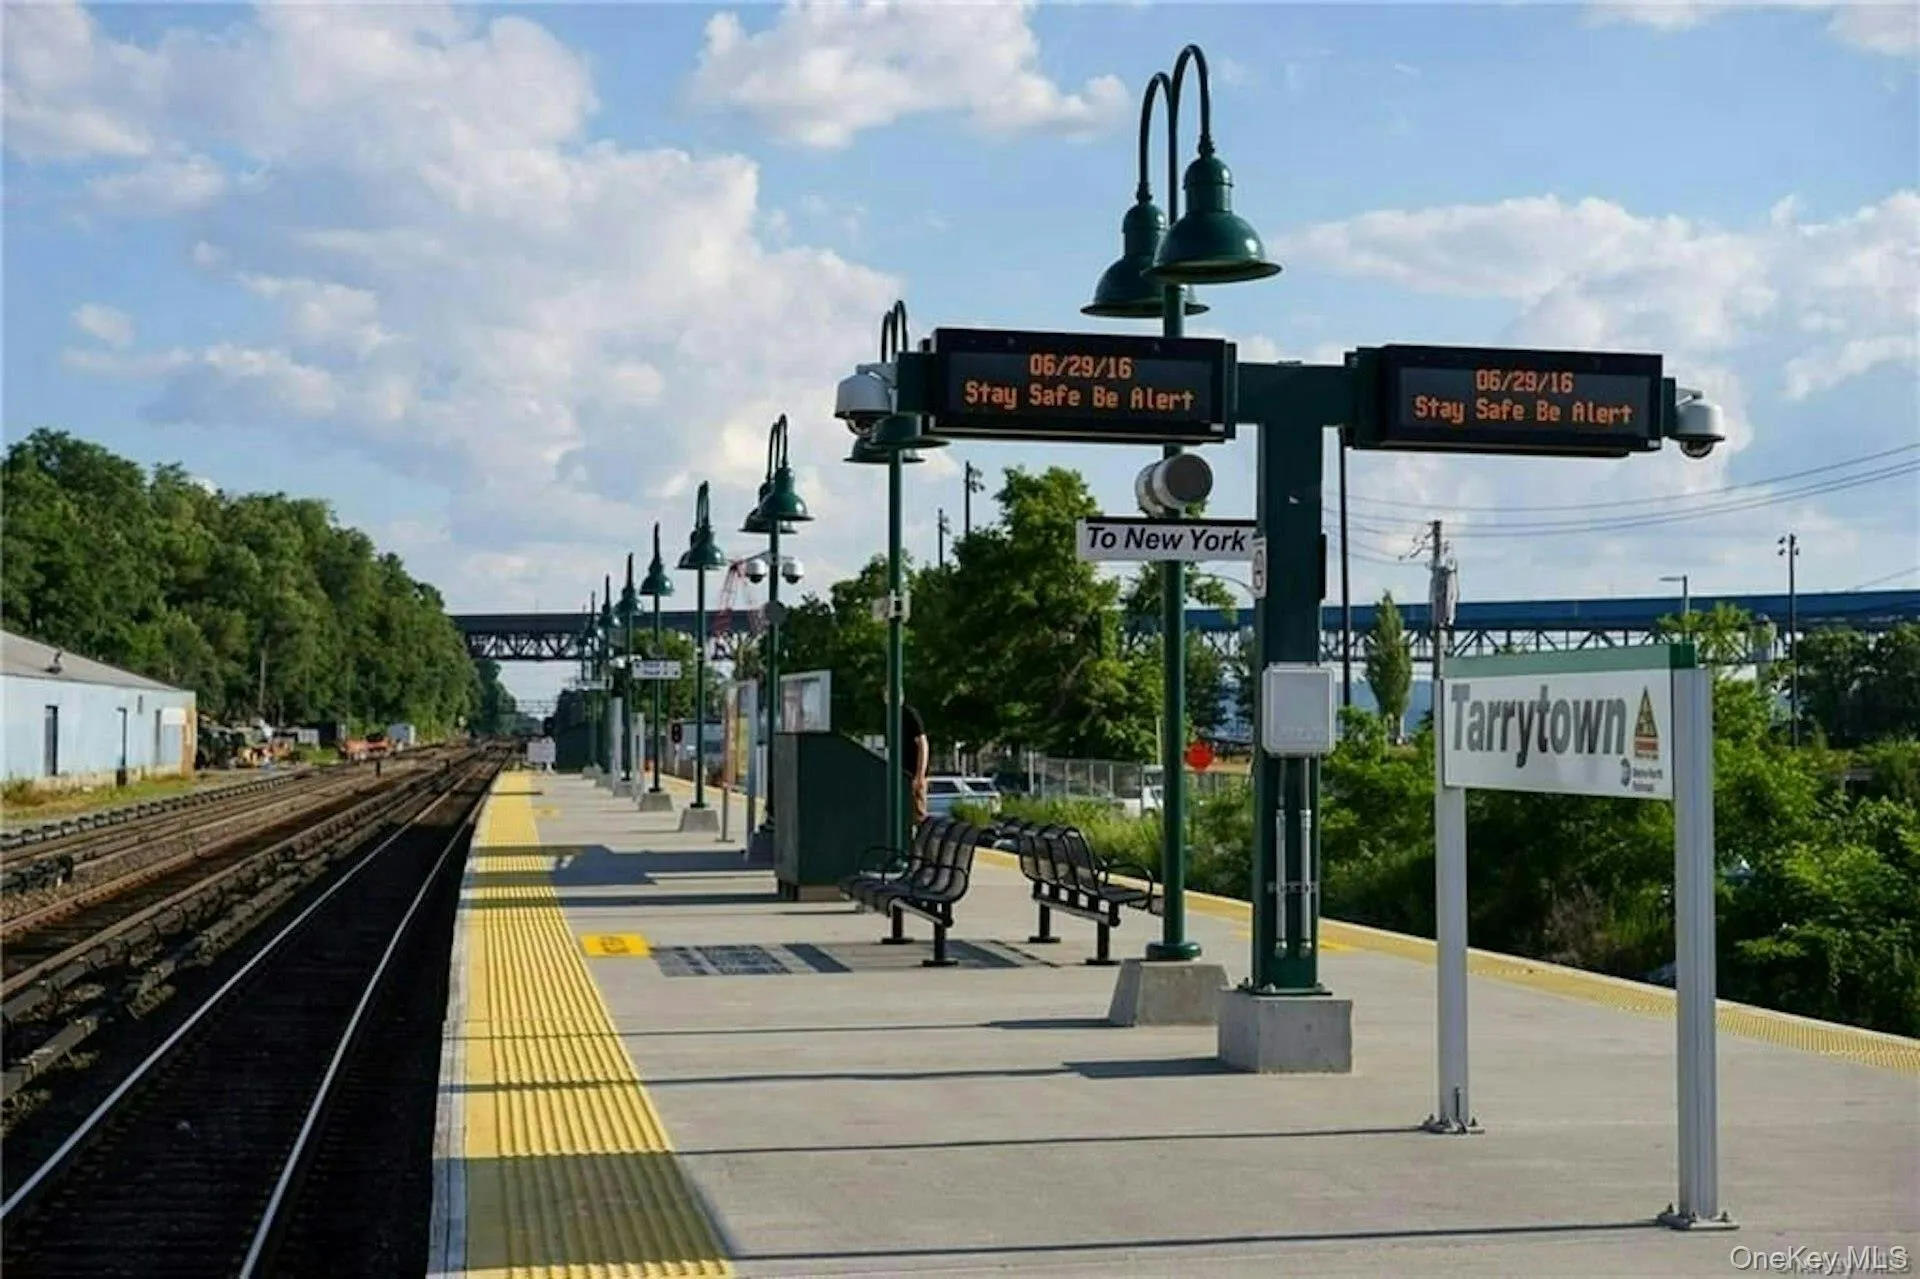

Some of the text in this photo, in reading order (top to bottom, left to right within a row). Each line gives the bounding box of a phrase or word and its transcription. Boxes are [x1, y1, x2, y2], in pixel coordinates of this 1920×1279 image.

[1030, 353, 1133, 379] 06/29/16
[1475, 369, 1574, 393] 06/29/16
[965, 380, 1194, 411] Stay Safe Be Alert
[1415, 396, 1633, 425] Stay Safe Be Alert
[1087, 526, 1248, 552] To New York
[1450, 684, 1627, 769] Tarrytown
